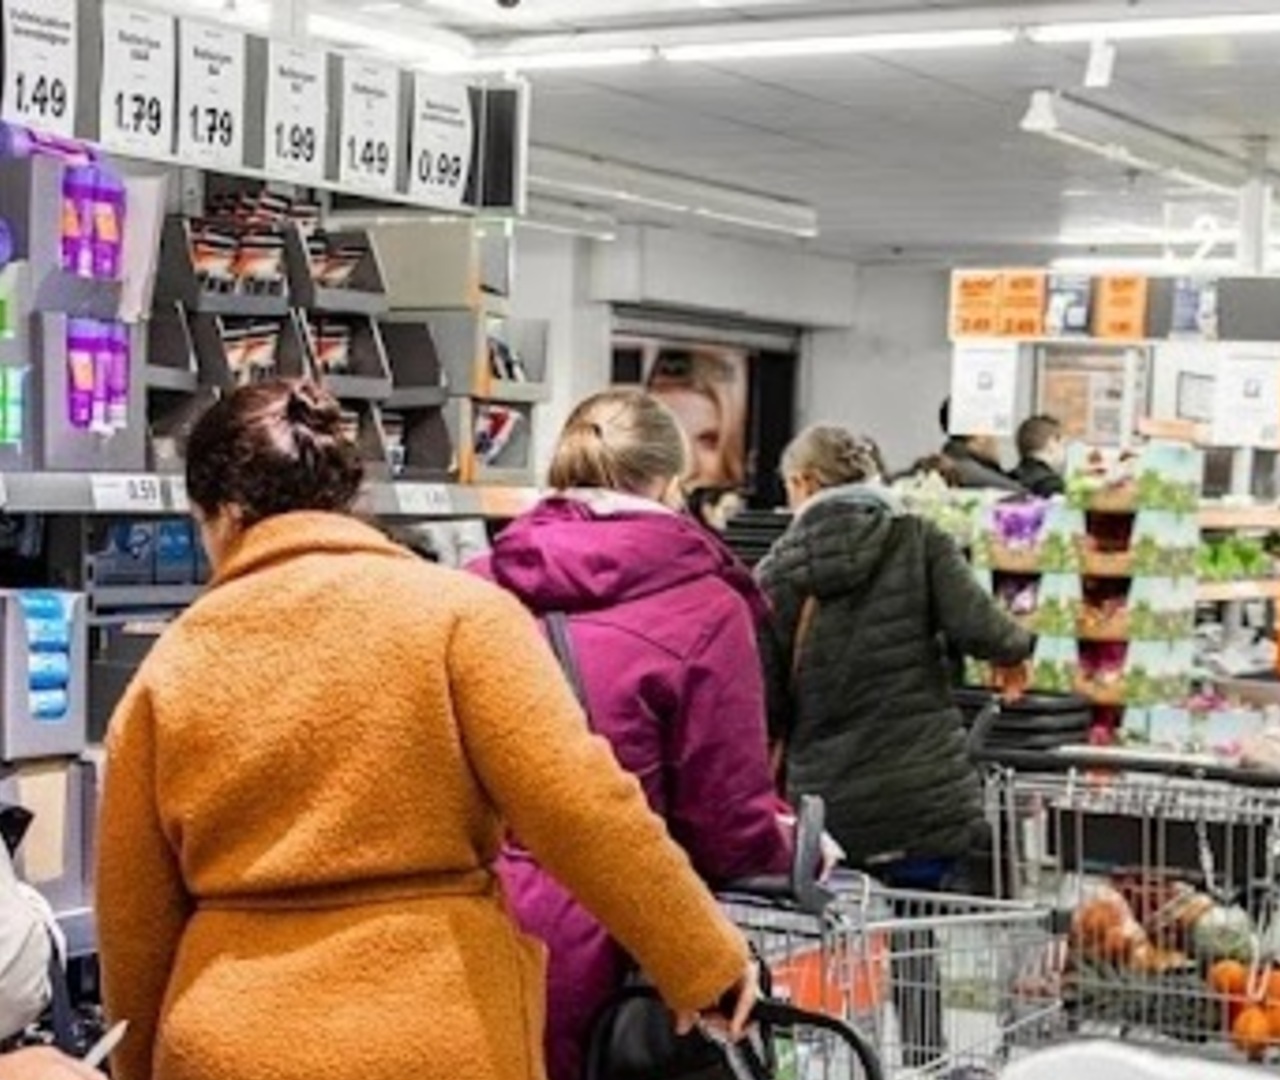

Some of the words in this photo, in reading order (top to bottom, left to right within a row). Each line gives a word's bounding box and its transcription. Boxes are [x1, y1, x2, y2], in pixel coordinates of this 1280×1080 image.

[16, 71, 67, 117] 1.49
[114, 91, 162, 136] 1.79
[189, 104, 233, 147] 1.79
[275, 121, 316, 163] 1.99
[347, 135, 390, 176] 1.49
[418, 149, 462, 188] 0.99
